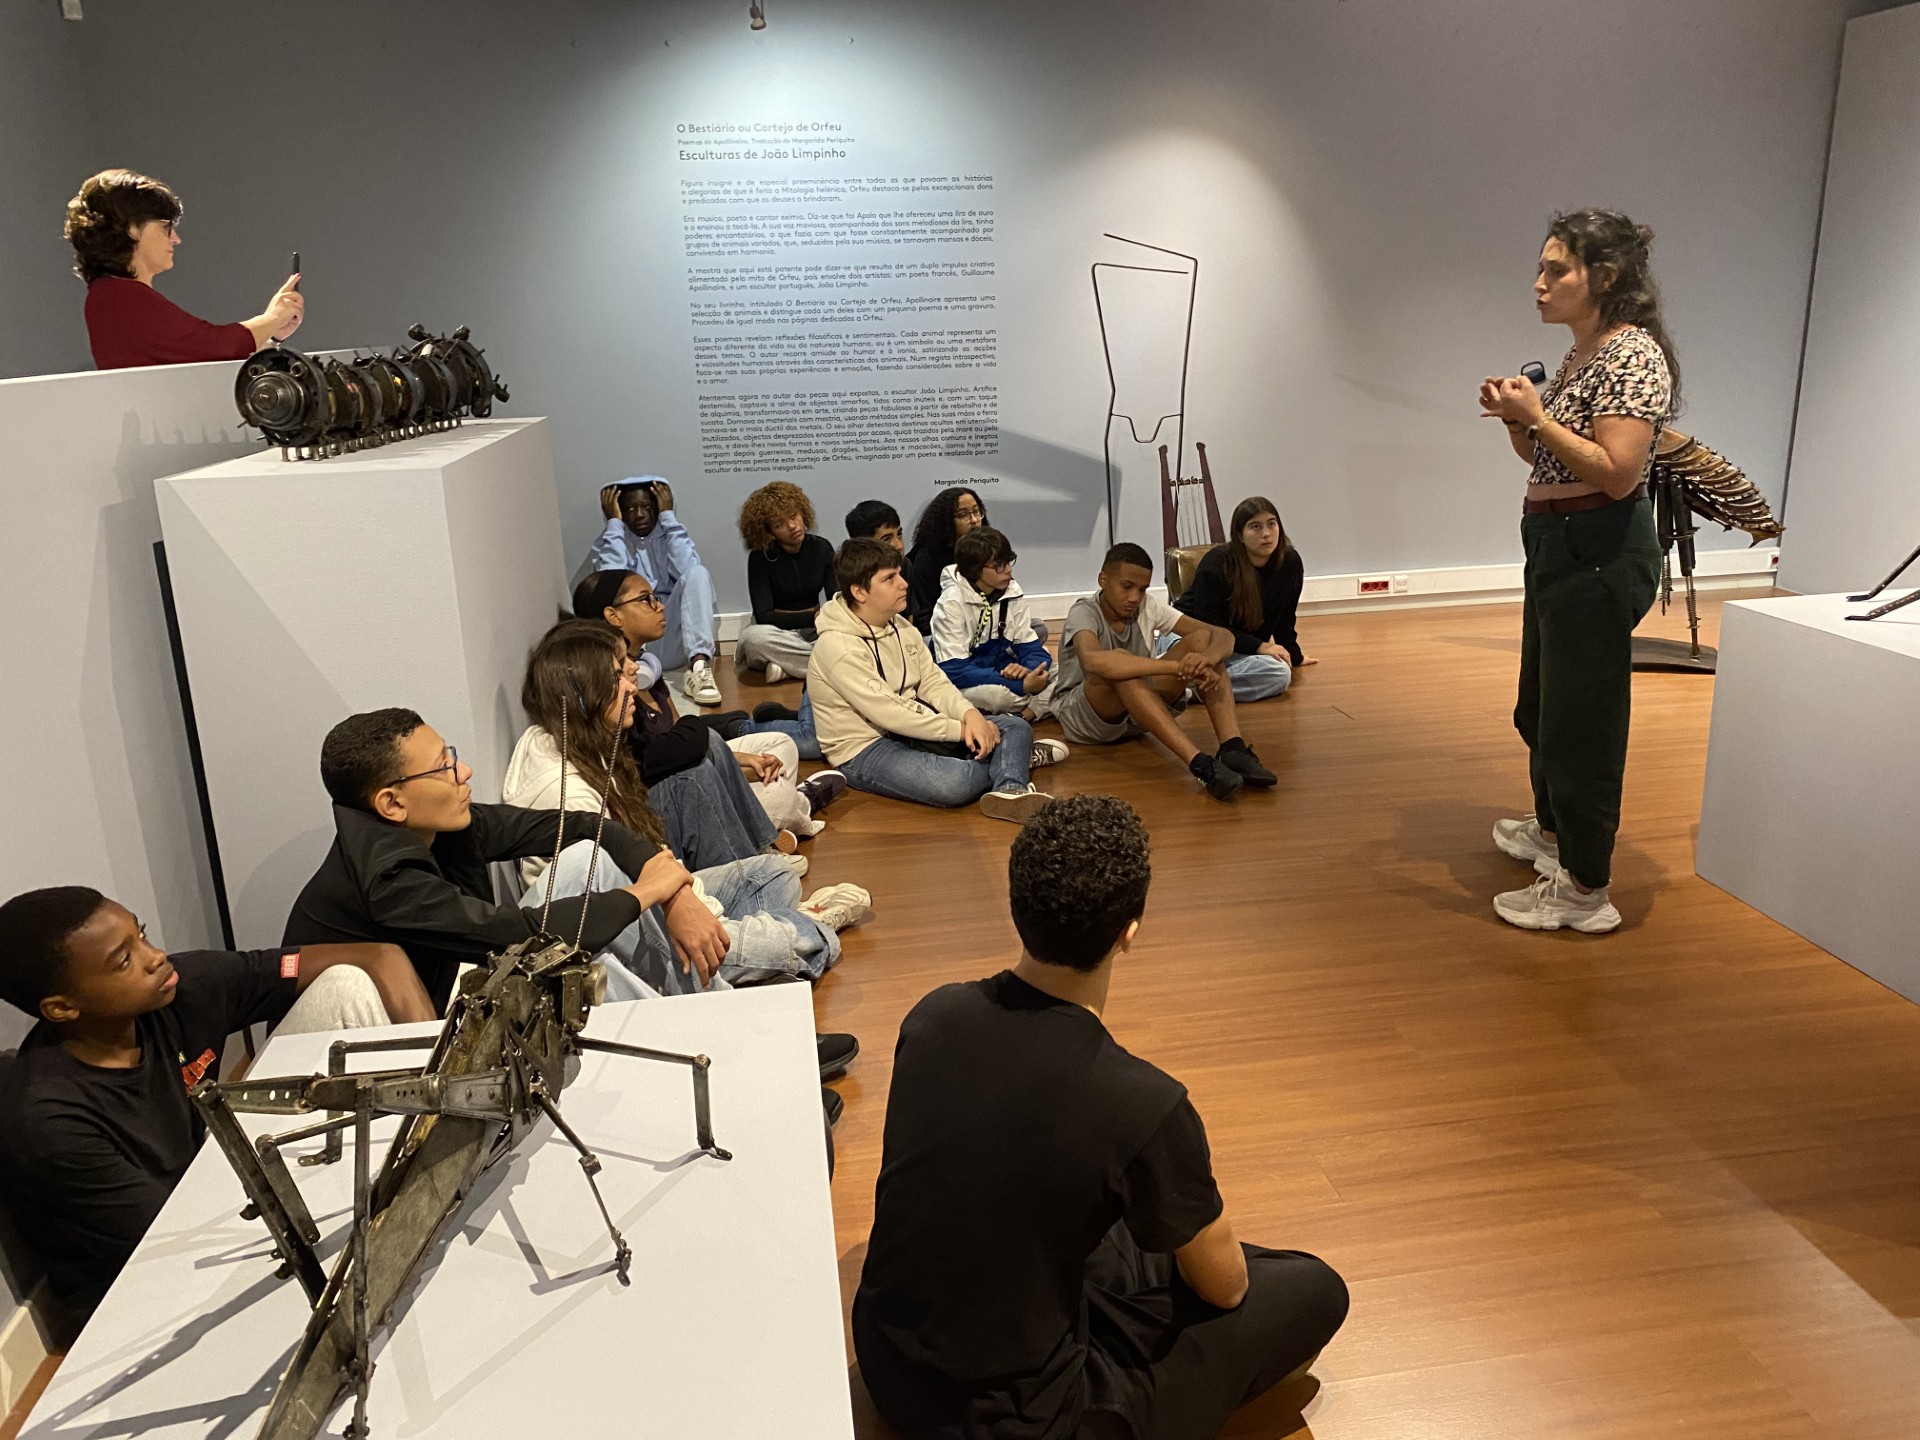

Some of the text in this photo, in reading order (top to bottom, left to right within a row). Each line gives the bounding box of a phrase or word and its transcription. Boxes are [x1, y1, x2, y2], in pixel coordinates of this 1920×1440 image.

[677, 123, 686, 132] O
[688, 122, 736, 132] Bestiário
[754, 122, 794, 134] Cortejo
[796, 121, 809, 131] de
[811, 121, 842, 131] Orfeu
[680, 148, 846, 161] Esculturas de João Limpinho
[681, 179, 704, 189] Figura
[707, 179, 733, 188] insigne
[759, 178, 788, 188] especial
[685, 232, 713, 242] poderes
[739, 265, 755, 275] aqui
[774, 264, 802, 274] patente
[804, 264, 822, 274] pode
[824, 263, 851, 271] dizer-se
[869, 262, 893, 270] resulta
[920, 261, 940, 271] duplo
[942, 260, 968, 270] impulso
[970, 259, 995, 268] criativo
[749, 282, 777, 290] escultor
[840, 297, 866, 307] Cortejo
[944, 294, 977, 304] apresenta
[691, 317, 725, 325] Procedeu
[736, 316, 754, 326] igual
[755, 316, 776, 324] modo
[820, 314, 855, 322] dedicadas
[744, 334, 773, 342] revelam
[921, 329, 945, 337] animal
[696, 368, 722, 376] foca-se
[876, 362, 903, 371] fazendo
[955, 360, 973, 368] sobre
[983, 359, 997, 367] vida
[743, 432, 772, 442] objectos
[913, 426, 939, 434] trazidos
[940, 425, 954, 435] pela
[984, 423, 998, 433] pelo
[703, 449, 731, 460] surgiam
[734, 448, 756, 458] depois
[967, 440, 982, 450] hoje
[984, 440, 998, 450] aqui
[704, 465, 731, 474] escultor
[934, 476, 999, 488] Margarida Periquito
